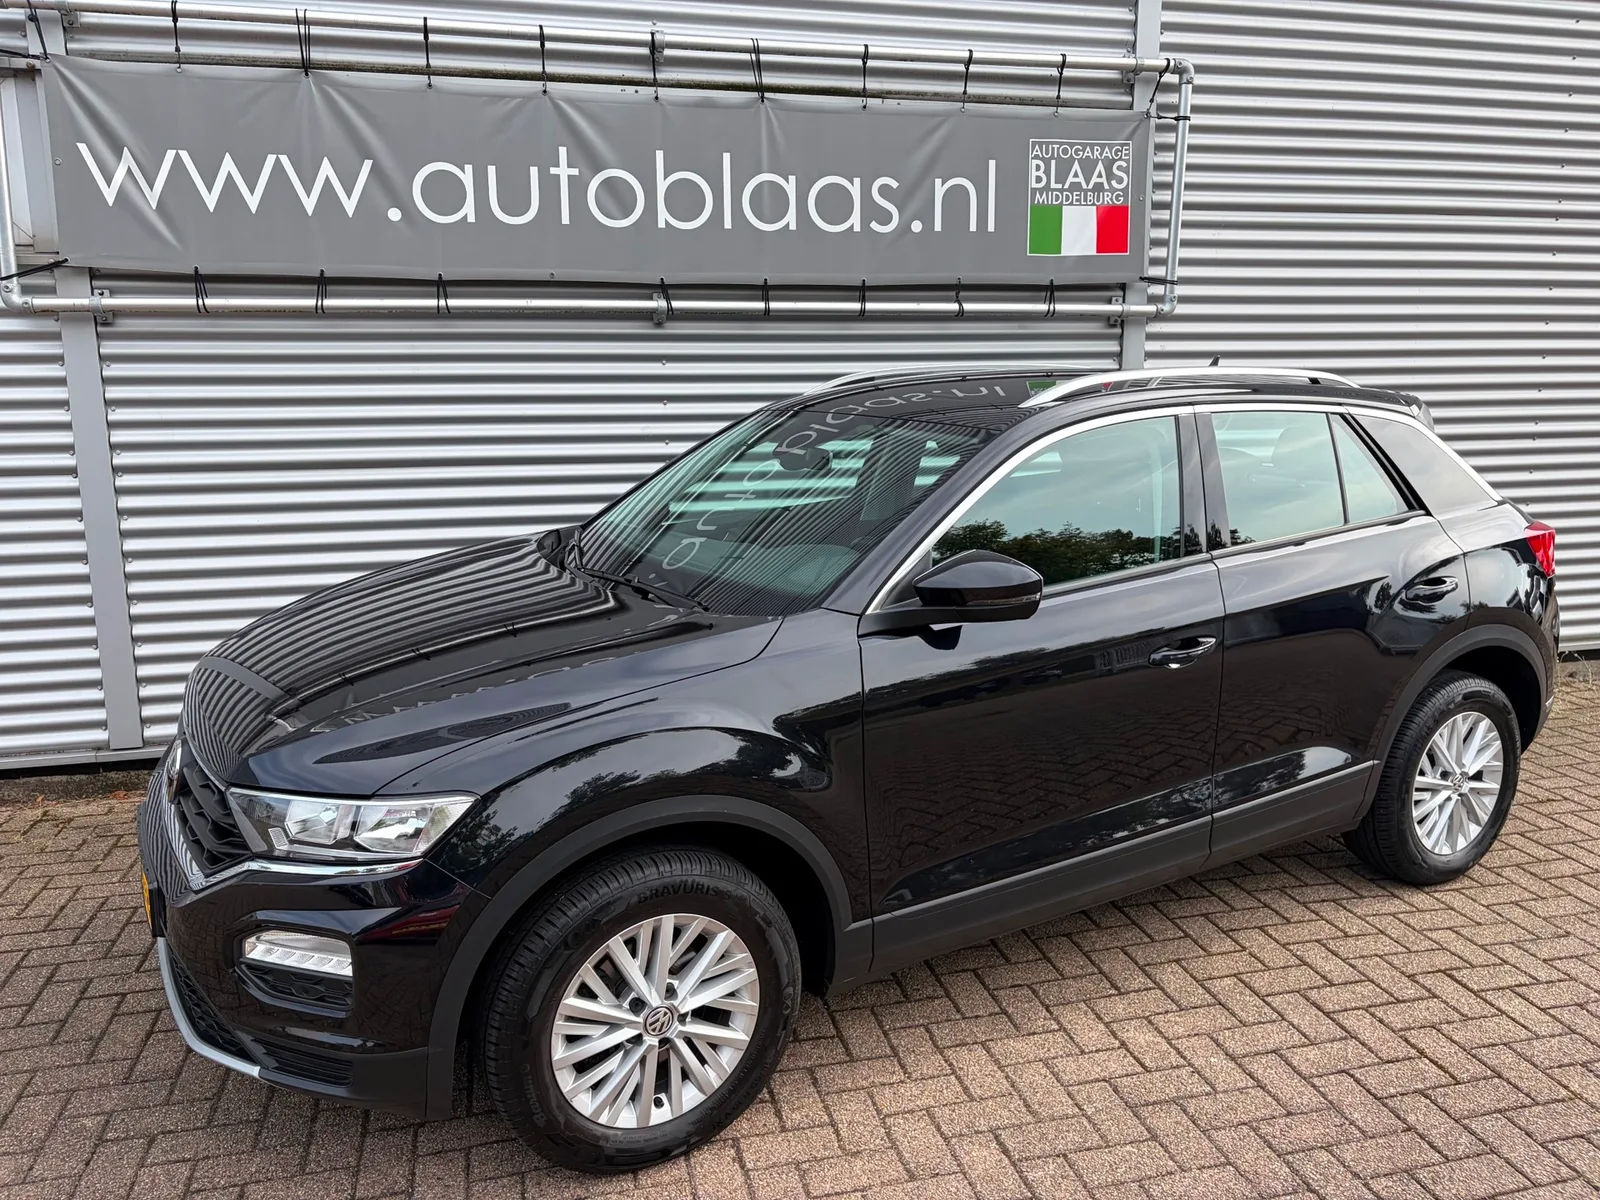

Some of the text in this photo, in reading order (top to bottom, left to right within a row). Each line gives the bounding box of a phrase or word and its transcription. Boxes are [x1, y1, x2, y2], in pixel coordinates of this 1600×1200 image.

[1031, 144, 1130, 159] AUTOGARAGE
[1031, 159, 1129, 189] BLAAS
[76, 142, 996, 233] www.autoblaas.nl
[1034, 190, 1124, 205] MIDDELBURG
[636, 882, 720, 904] BRAVURIS
